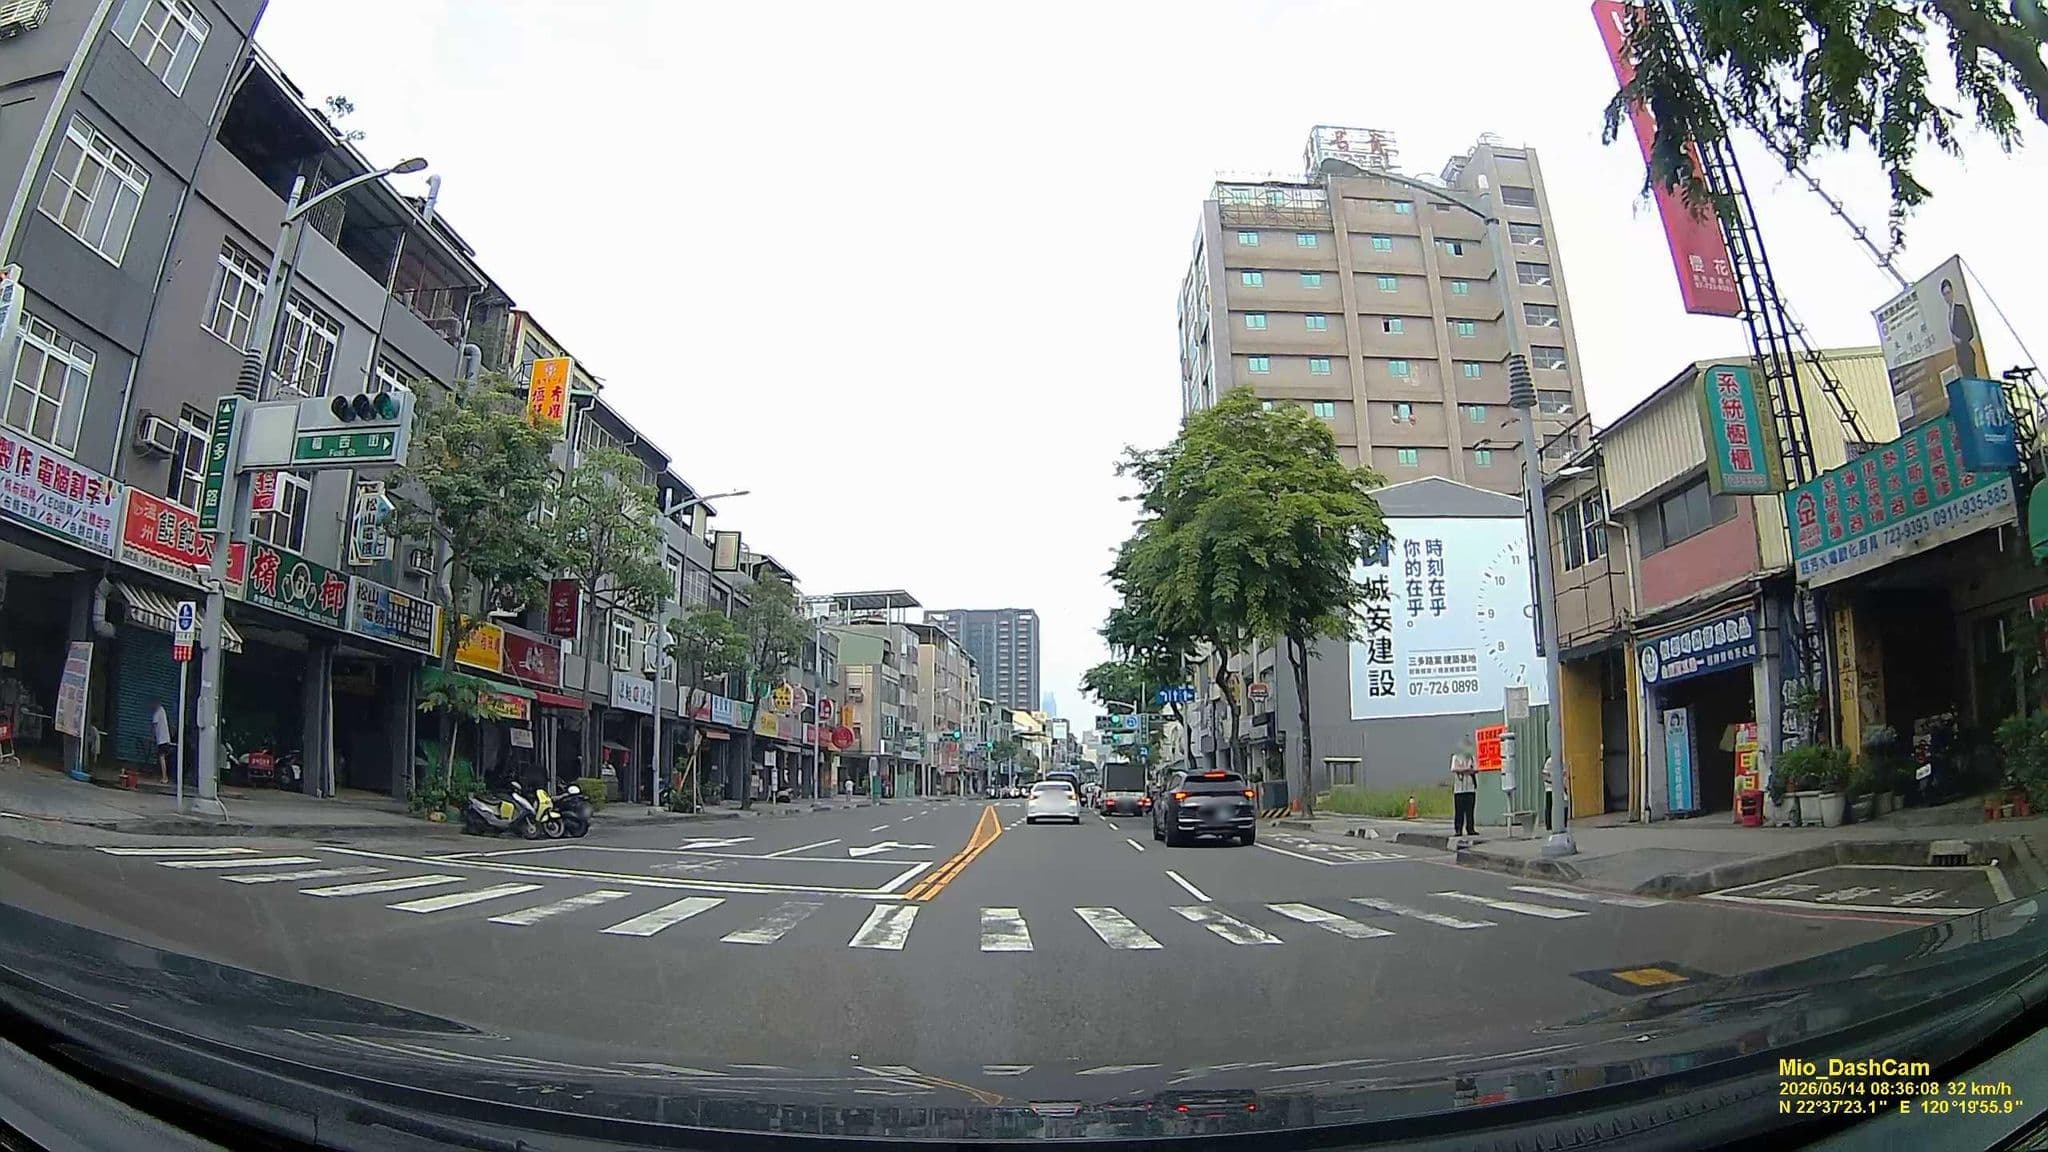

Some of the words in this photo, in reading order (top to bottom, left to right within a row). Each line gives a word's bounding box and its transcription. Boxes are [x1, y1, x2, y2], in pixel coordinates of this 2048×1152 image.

[205, 419, 231, 507] 三多一路
[1884, 516, 1930, 545] 723-9393
[1933, 485, 2008, 527] 0911-935-885
[1425, 538, 1447, 617] 時刻在乎
[1494, 575, 1505, 586] 10
[1487, 608, 1495, 618] 9
[1365, 574, 1396, 697] 城安建設
[1498, 641, 1505, 651] 8
[1409, 680, 1449, 696] 07-726
[1451, 679, 1479, 693] 0898
